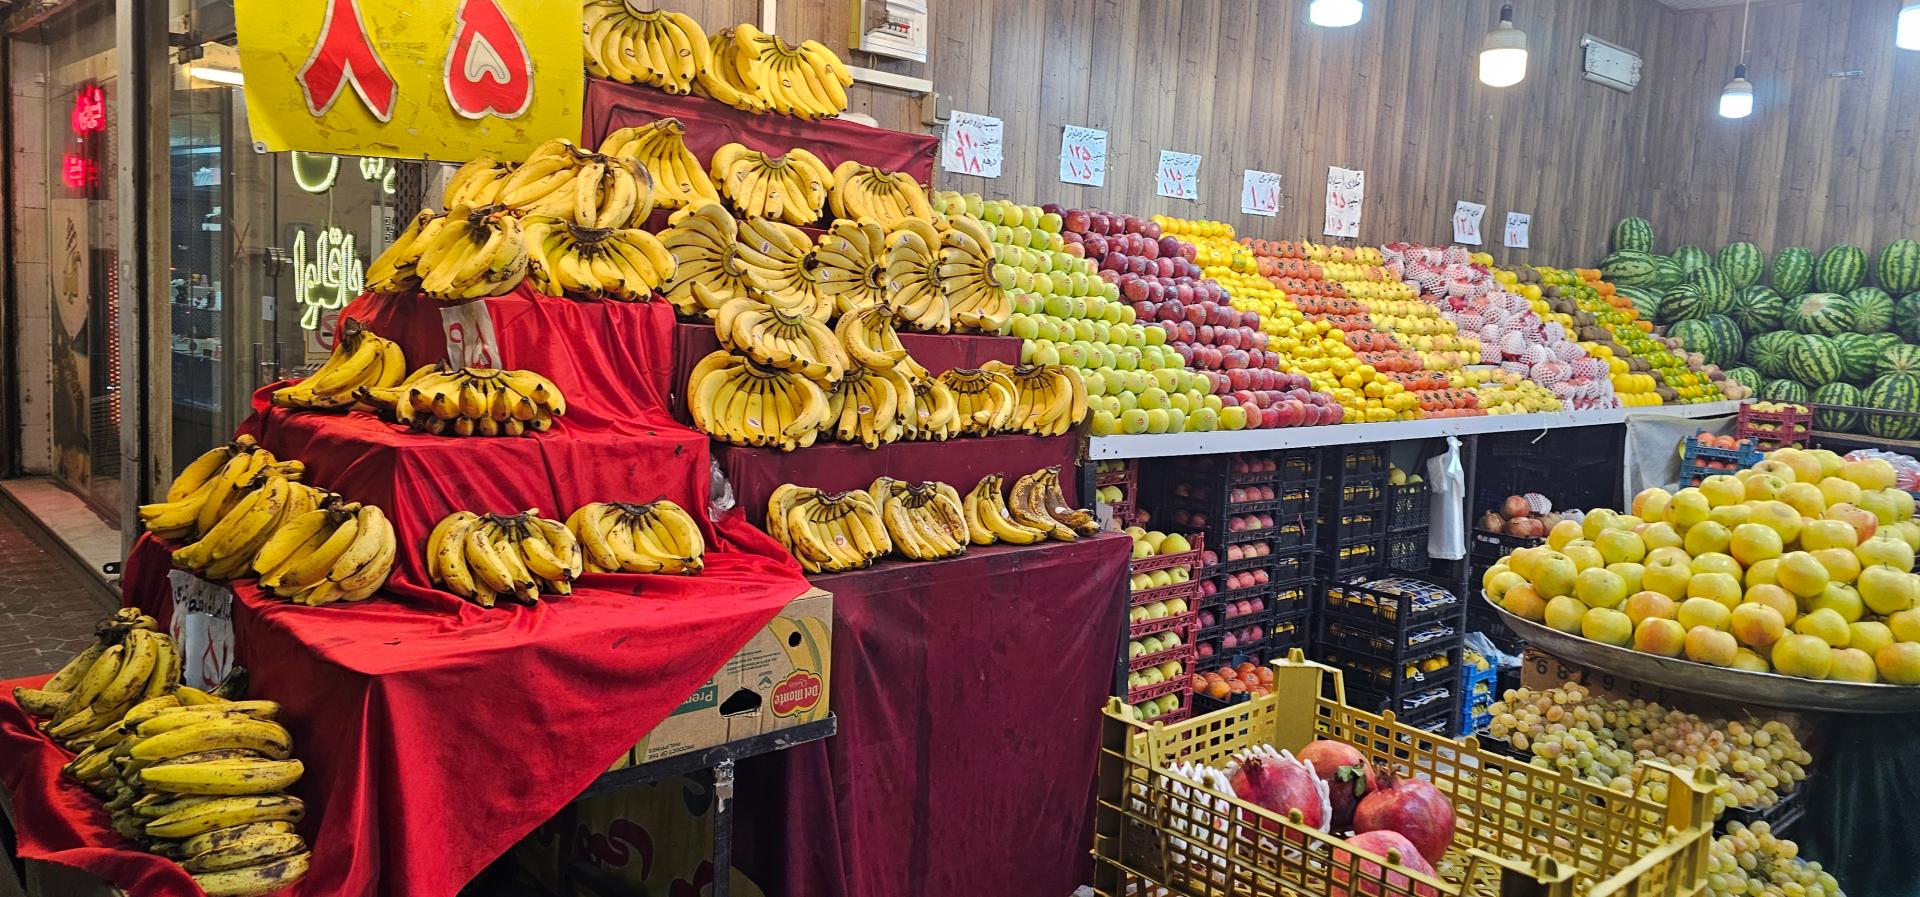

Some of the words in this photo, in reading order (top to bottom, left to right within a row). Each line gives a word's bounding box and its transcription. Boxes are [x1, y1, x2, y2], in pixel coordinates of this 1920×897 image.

[296, 0, 534, 122] ۸۵
[954, 146, 981, 173] ۹۸
[1069, 144, 1091, 161] ۱۲۵
[1069, 161, 1092, 180] ۱۰۵
[1164, 168, 1182, 182] ۱۱۵
[1163, 183, 1184, 196] ۱۰۵
[1252, 186, 1277, 210] ۱۰۵
[774, 688, 804, 706] Monte
[804, 684, 819, 699] Del
